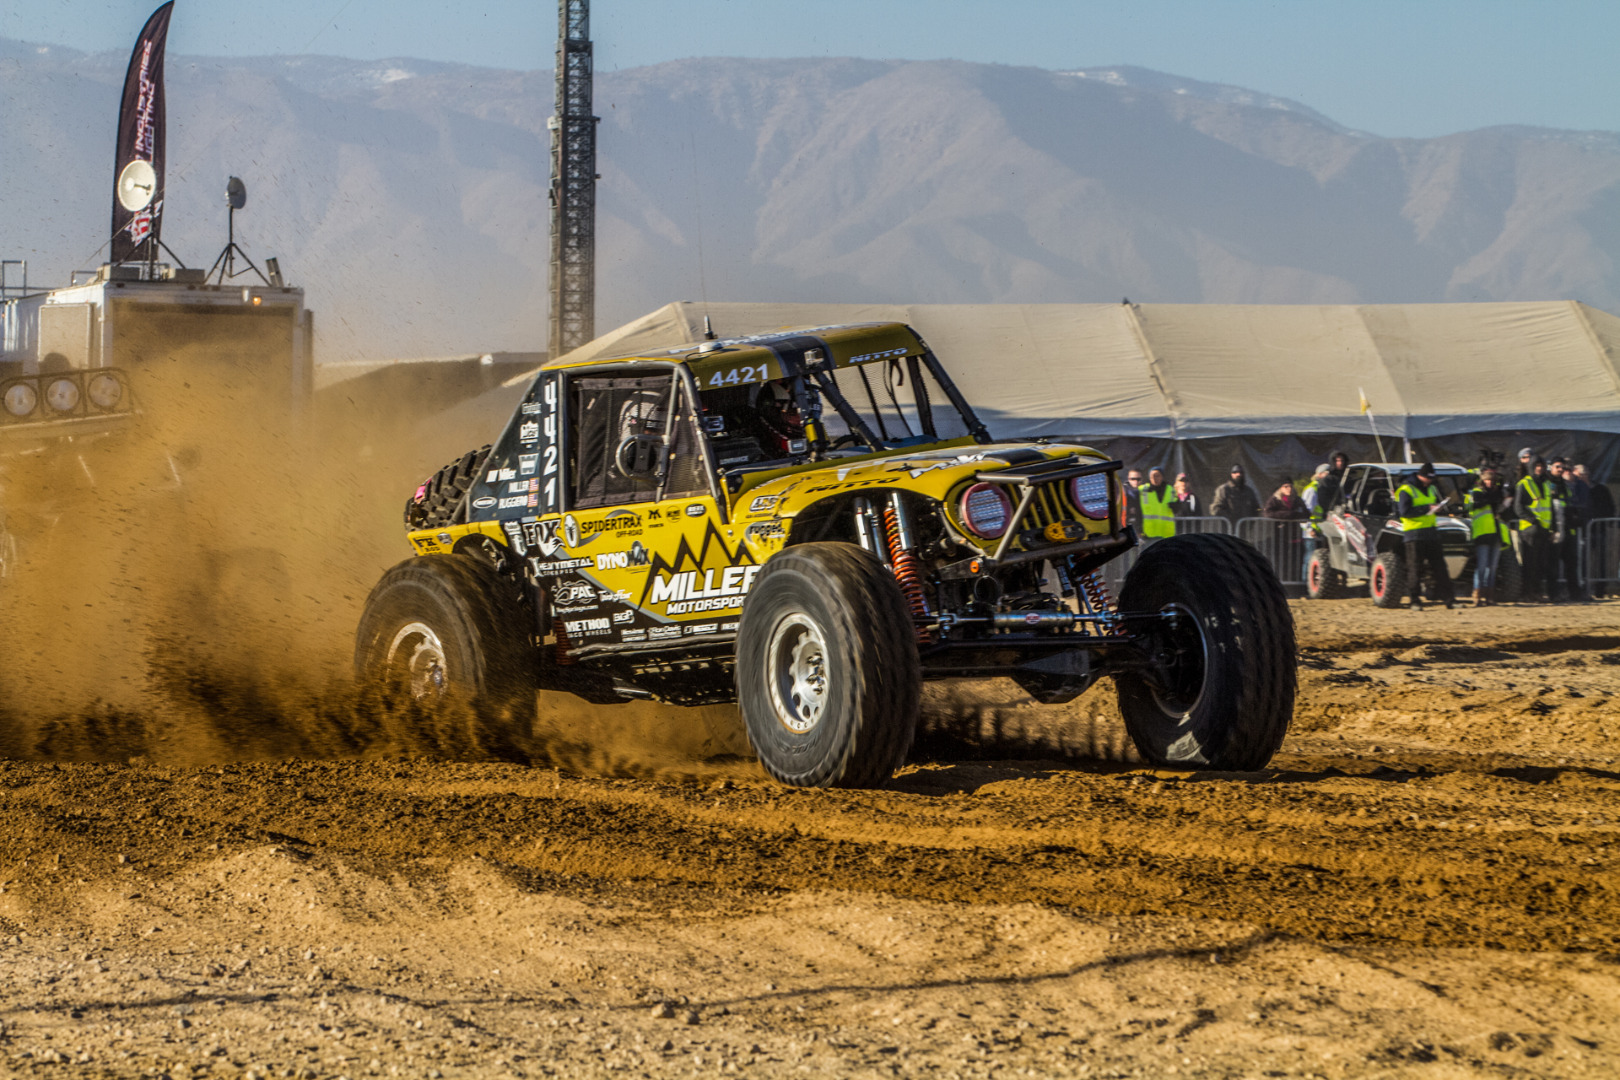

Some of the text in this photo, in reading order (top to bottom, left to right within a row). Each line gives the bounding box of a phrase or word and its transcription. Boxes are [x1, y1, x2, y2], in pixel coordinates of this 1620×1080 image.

[849, 347, 908, 364] NITTO
[709, 364, 769, 387] 4421
[805, 477, 902, 494] NITTO
[581, 515, 642, 534] SPIDERTRAX
[523, 518, 565, 556] FOX
[570, 586, 597, 600] PAC
[565, 618, 610, 633] METHOD
